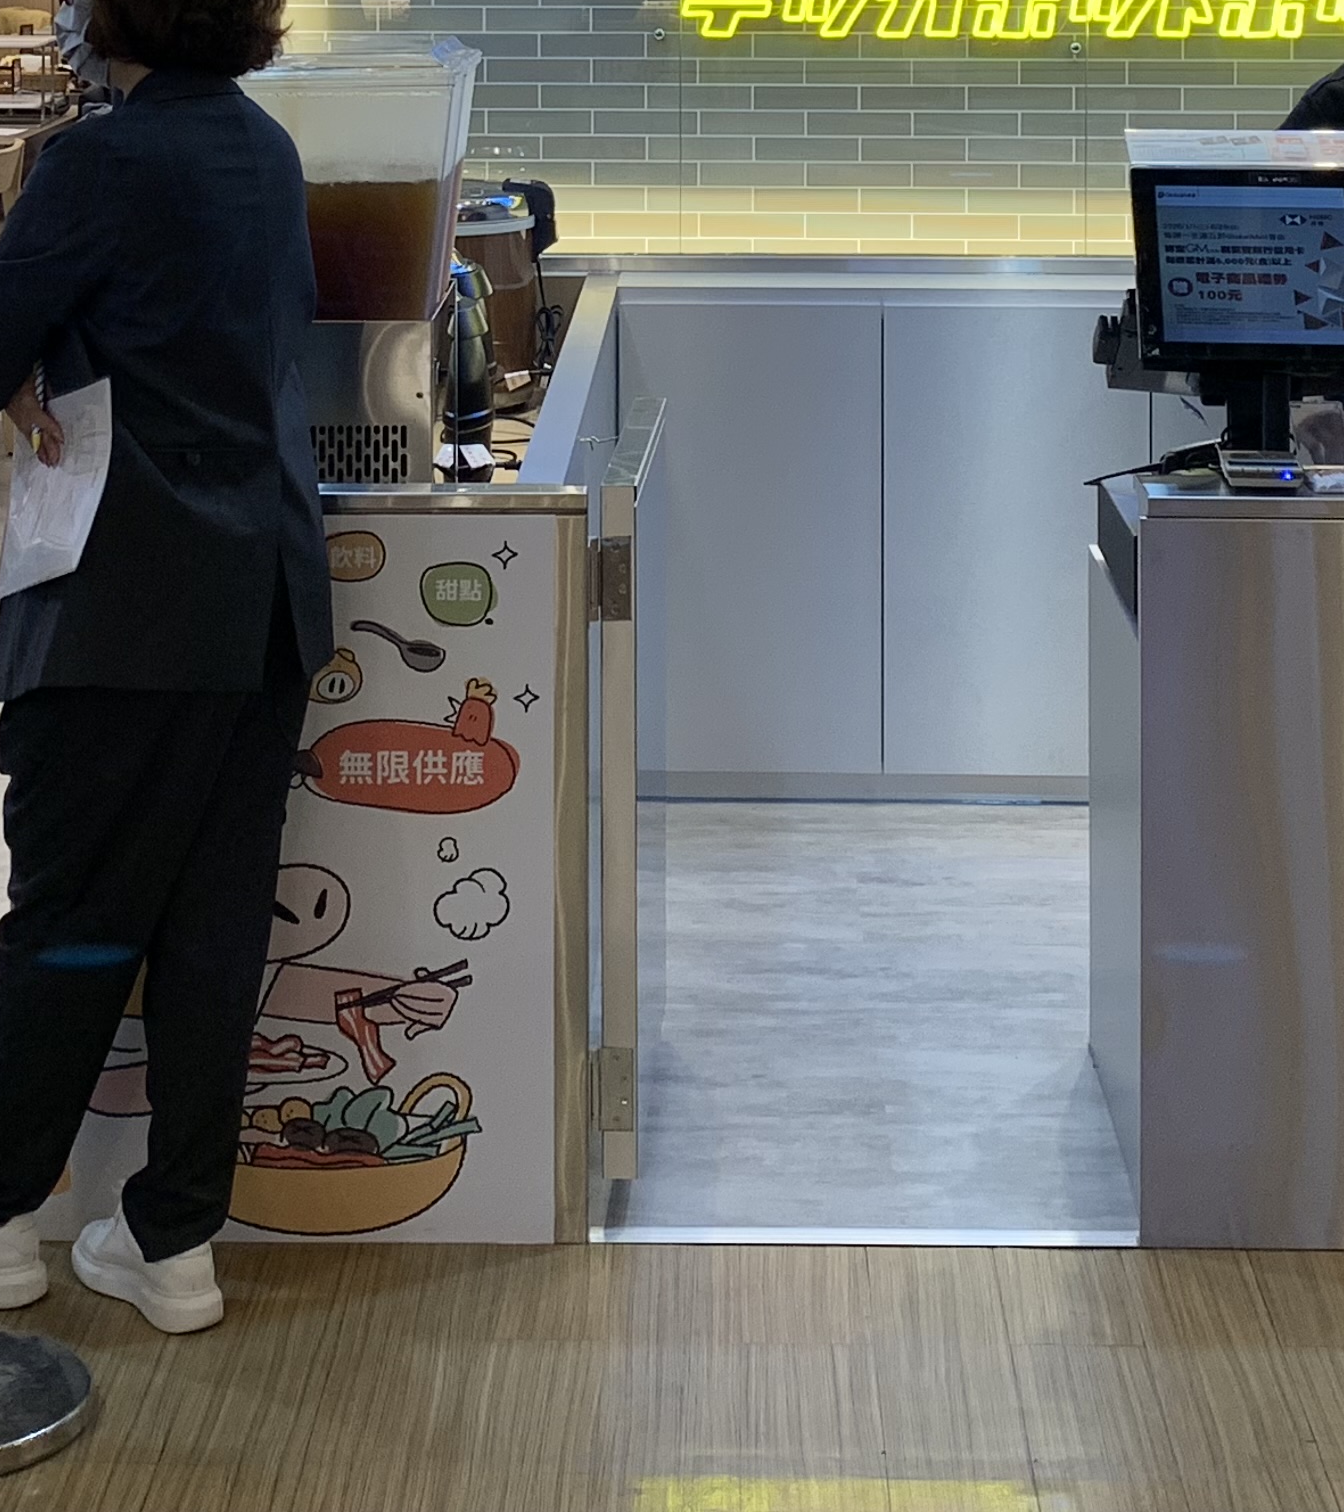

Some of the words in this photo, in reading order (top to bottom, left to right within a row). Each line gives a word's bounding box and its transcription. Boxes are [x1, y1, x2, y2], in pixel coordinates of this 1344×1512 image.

[330, 546, 377, 570] 飲料
[435, 579, 482, 601] 甜點
[339, 748, 485, 787] 無限供應
